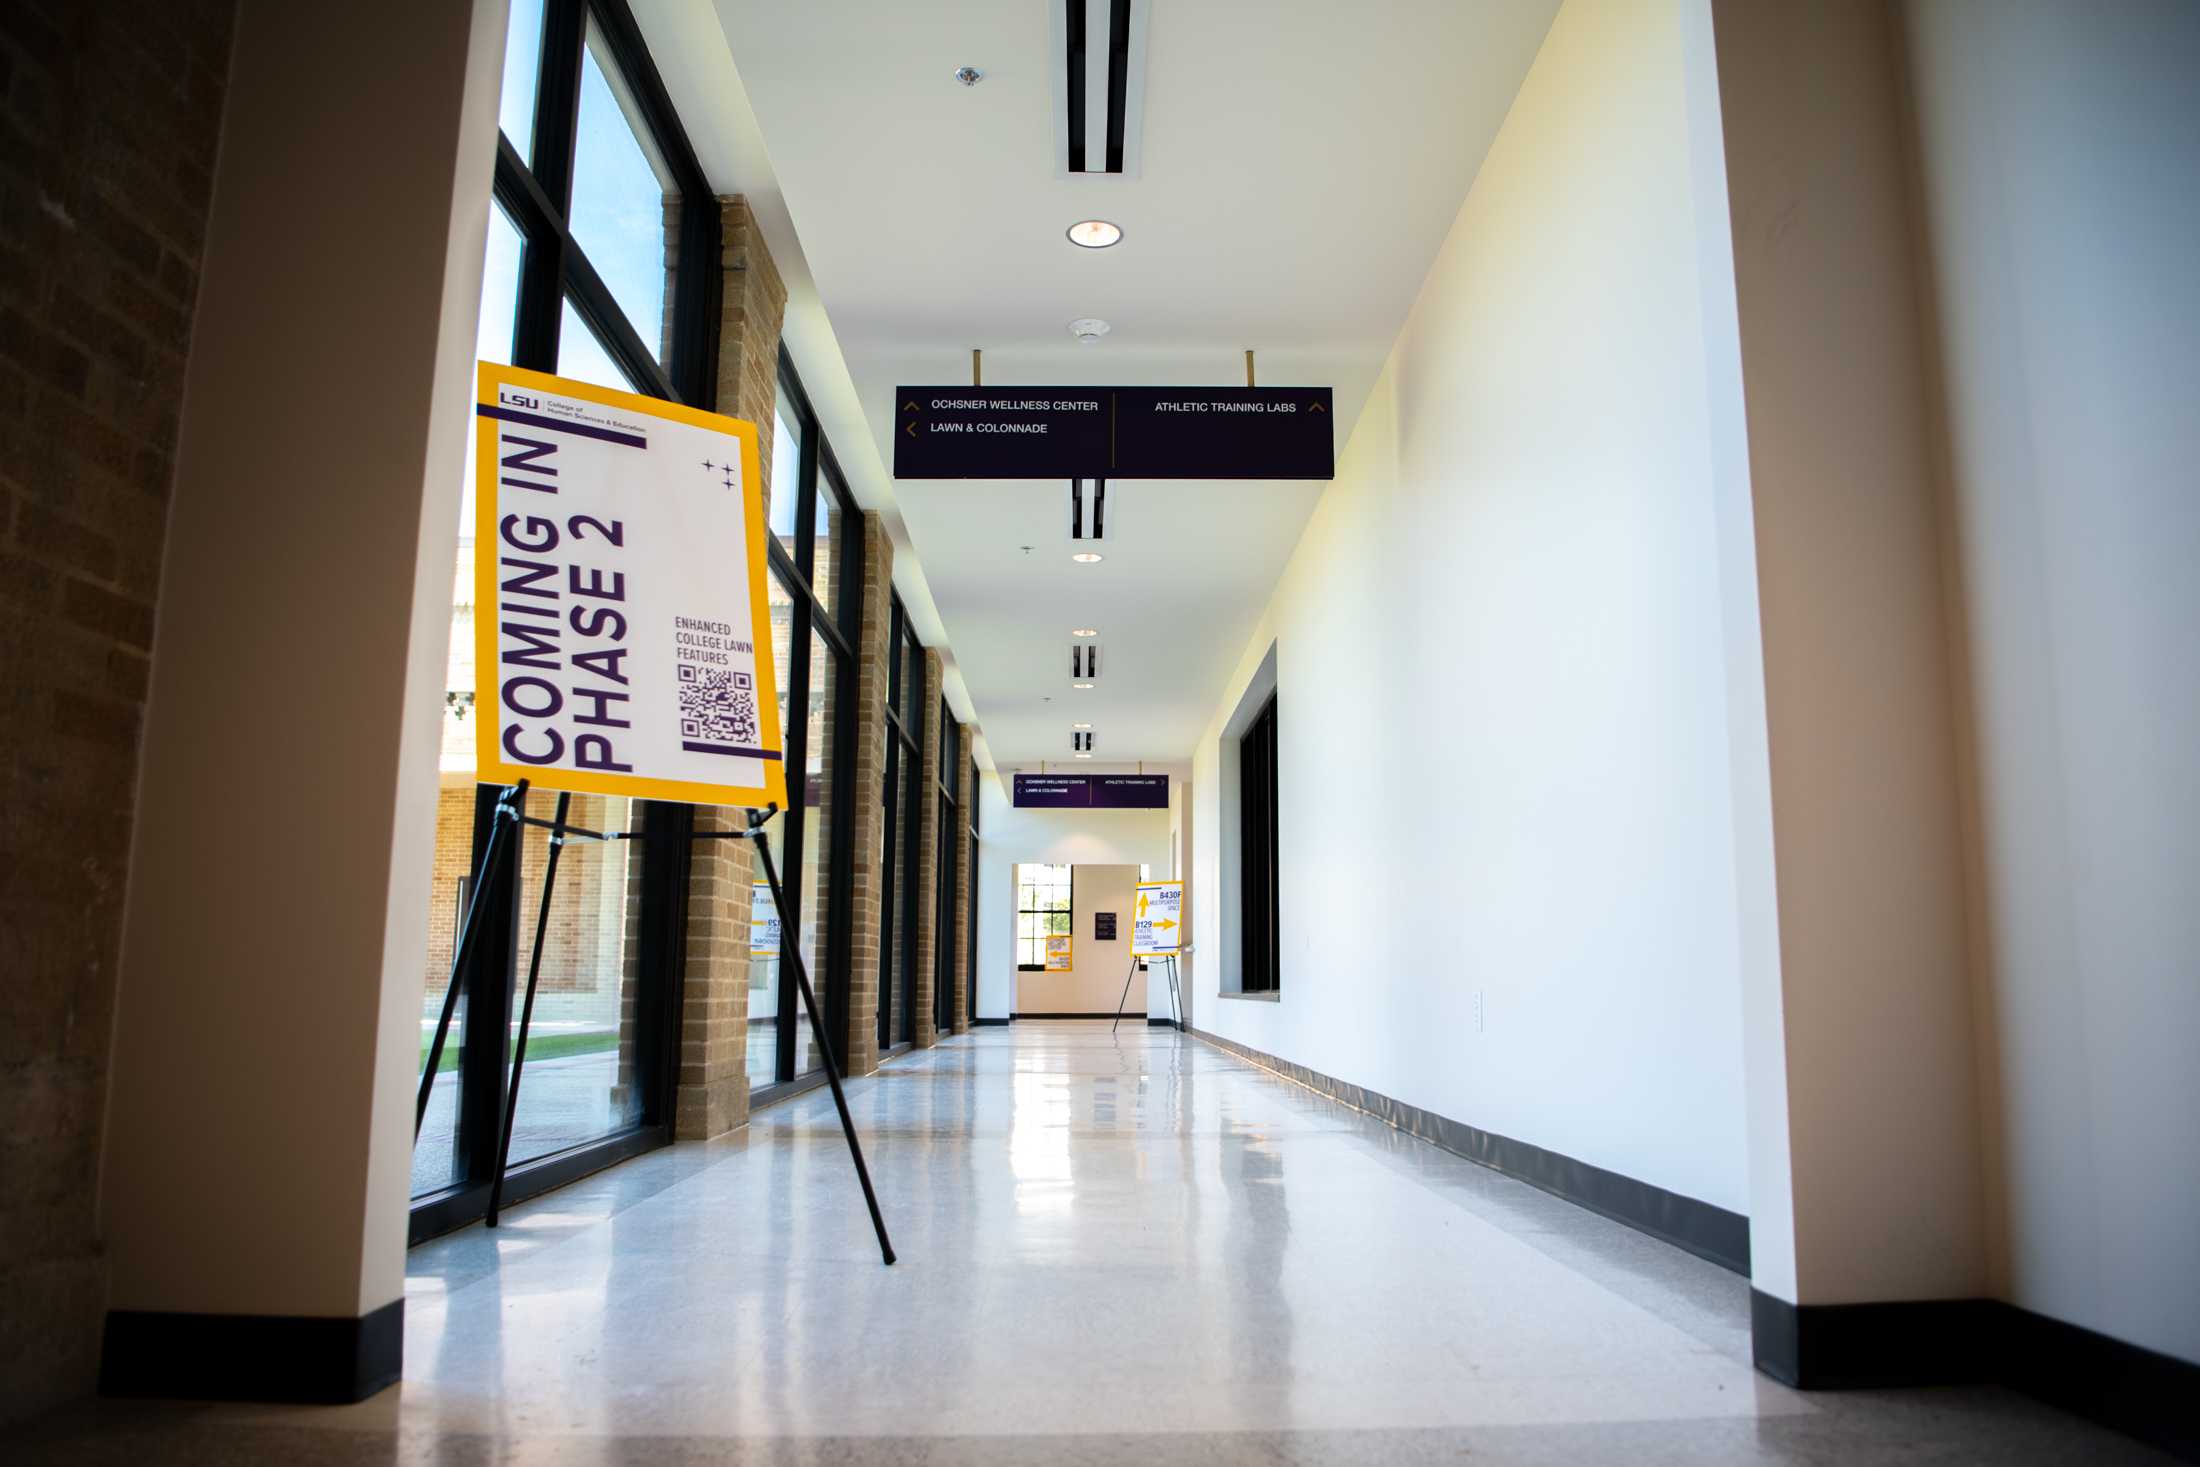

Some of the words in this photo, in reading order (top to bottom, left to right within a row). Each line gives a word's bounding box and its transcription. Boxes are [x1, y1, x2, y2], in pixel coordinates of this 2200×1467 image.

[500, 392, 538, 409] LSU
[547, 400, 574, 412] College
[931, 399, 987, 410] OCHSNER
[989, 400, 1050, 410] WELLNESS
[1053, 401, 1098, 411] CENTER
[1155, 402, 1208, 412] ATHLETIC
[1211, 402, 1264, 412] TRAINING
[1267, 403, 1296, 413] LABS
[547, 407, 573, 417] Human
[575, 413, 605, 424] Sciences
[613, 420, 646, 432] Education
[930, 423, 963, 432] LAWN
[966, 423, 974, 432] &
[976, 423, 1048, 433] COLONNADE
[501, 433, 559, 495] IN
[567, 515, 624, 548] 2
[675, 616, 731, 636] ENHANCED
[500, 513, 565, 766] COMING
[676, 632, 722, 650] COLLEGE
[724, 639, 753, 654] LAWN
[677, 647, 729, 665] FEATURES
[569, 563, 633, 773] PHASE
